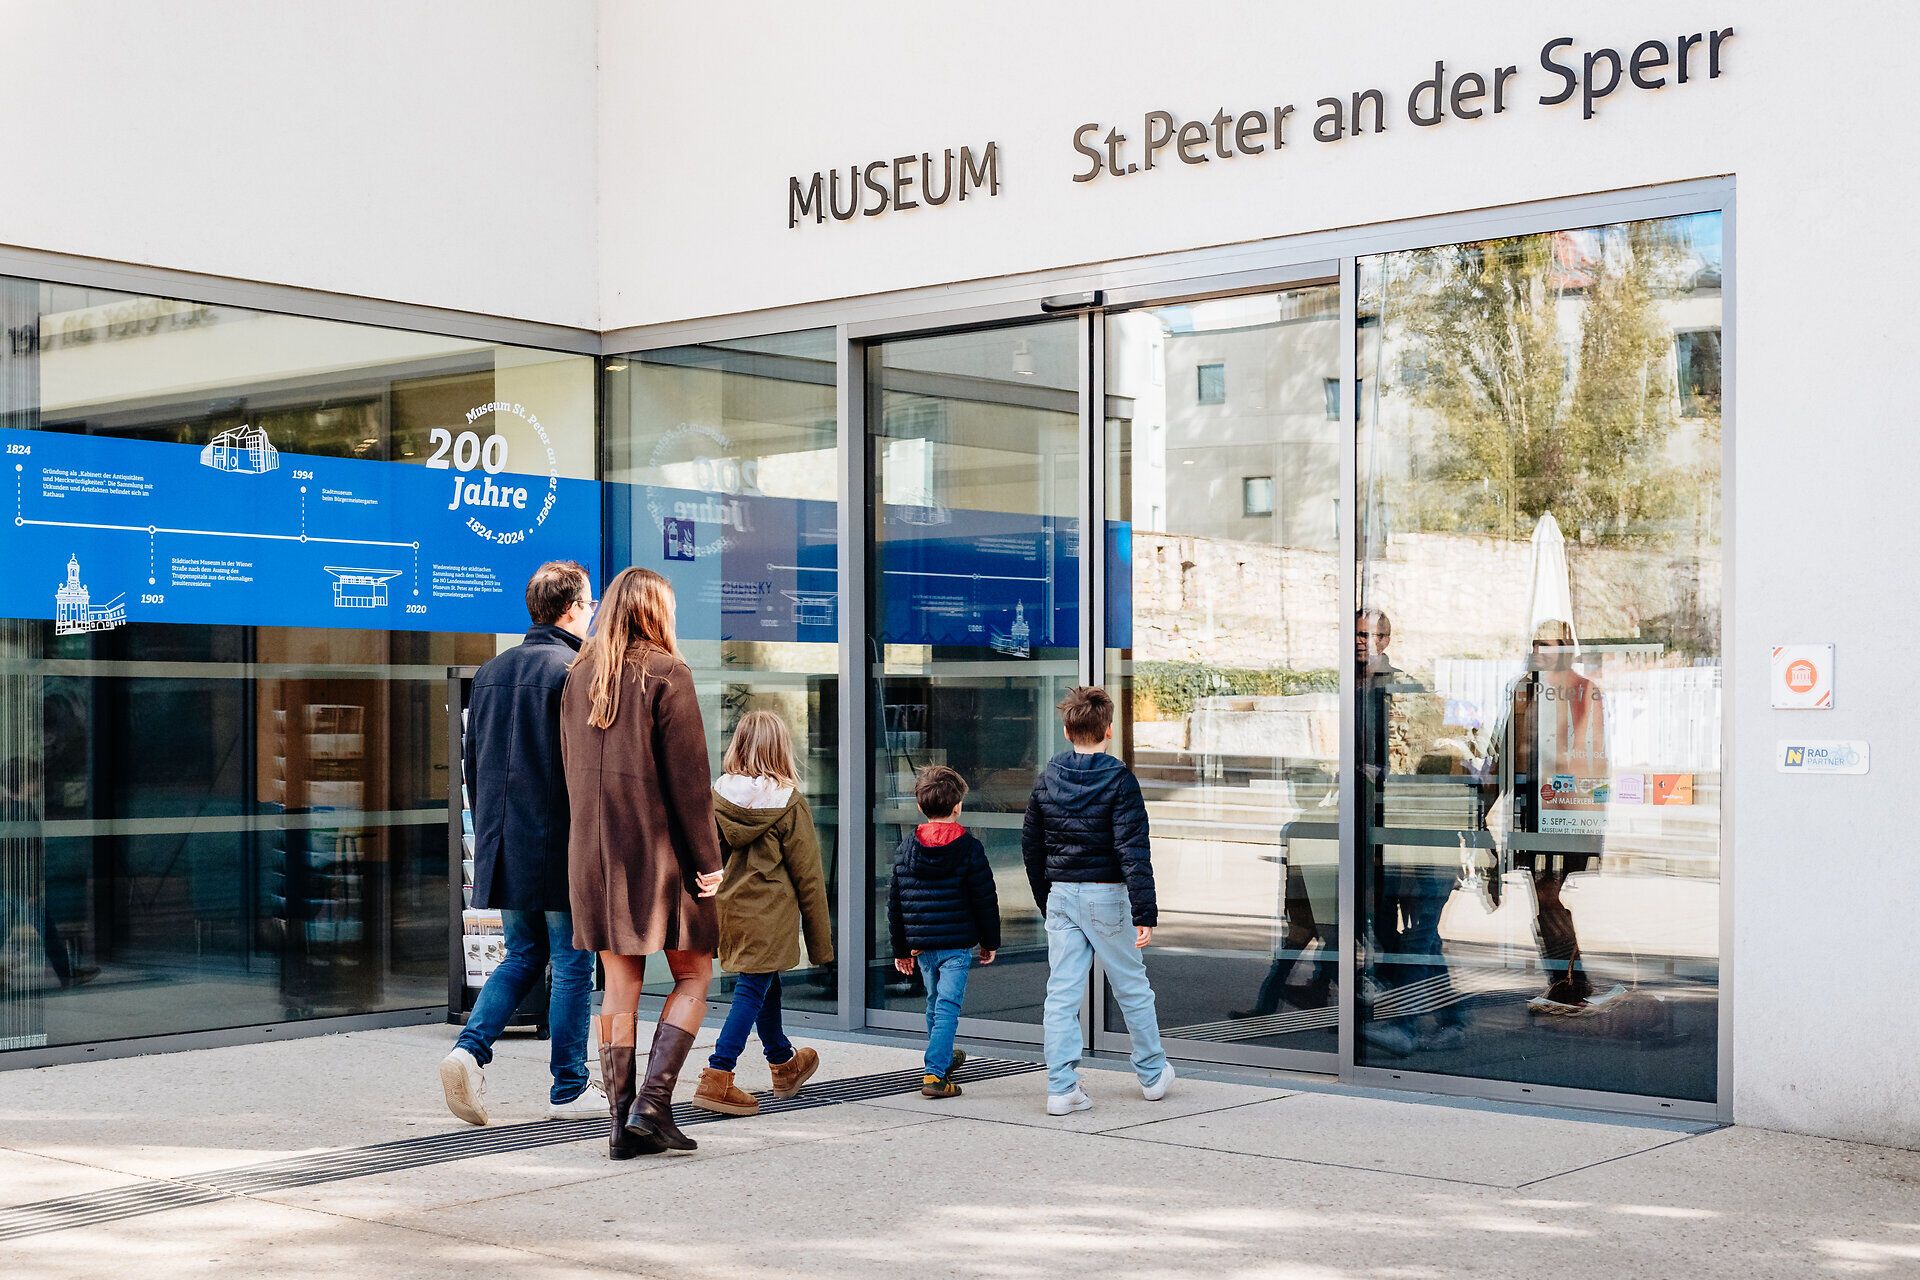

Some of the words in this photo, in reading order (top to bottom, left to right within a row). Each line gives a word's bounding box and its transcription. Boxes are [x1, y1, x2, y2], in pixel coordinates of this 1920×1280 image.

[788, 141, 999, 229] MUSEUM
[1313, 88, 1385, 143] an
[1407, 60, 1517, 126] der
[1538, 26, 1734, 120] Sperr
[465, 401, 511, 424] Museum
[512, 403, 526, 419] St.
[527, 414, 551, 446] Peter
[6, 444, 31, 456] 1824
[425, 428, 508, 475] 200
[546, 447, 558, 465] an
[42, 468, 68, 476] Gründung
[292, 470, 314, 480] 1994
[548, 468, 560, 492] der
[117, 481, 144, 489] Sammlung
[448, 476, 528, 510] Jahre
[536, 492, 557, 526] Sperr
[140, 594, 164, 604] 1903
[406, 604, 427, 614] 2020
[1808, 749, 1828, 758] RAD
[1808, 758, 1845, 766] PARTNER
